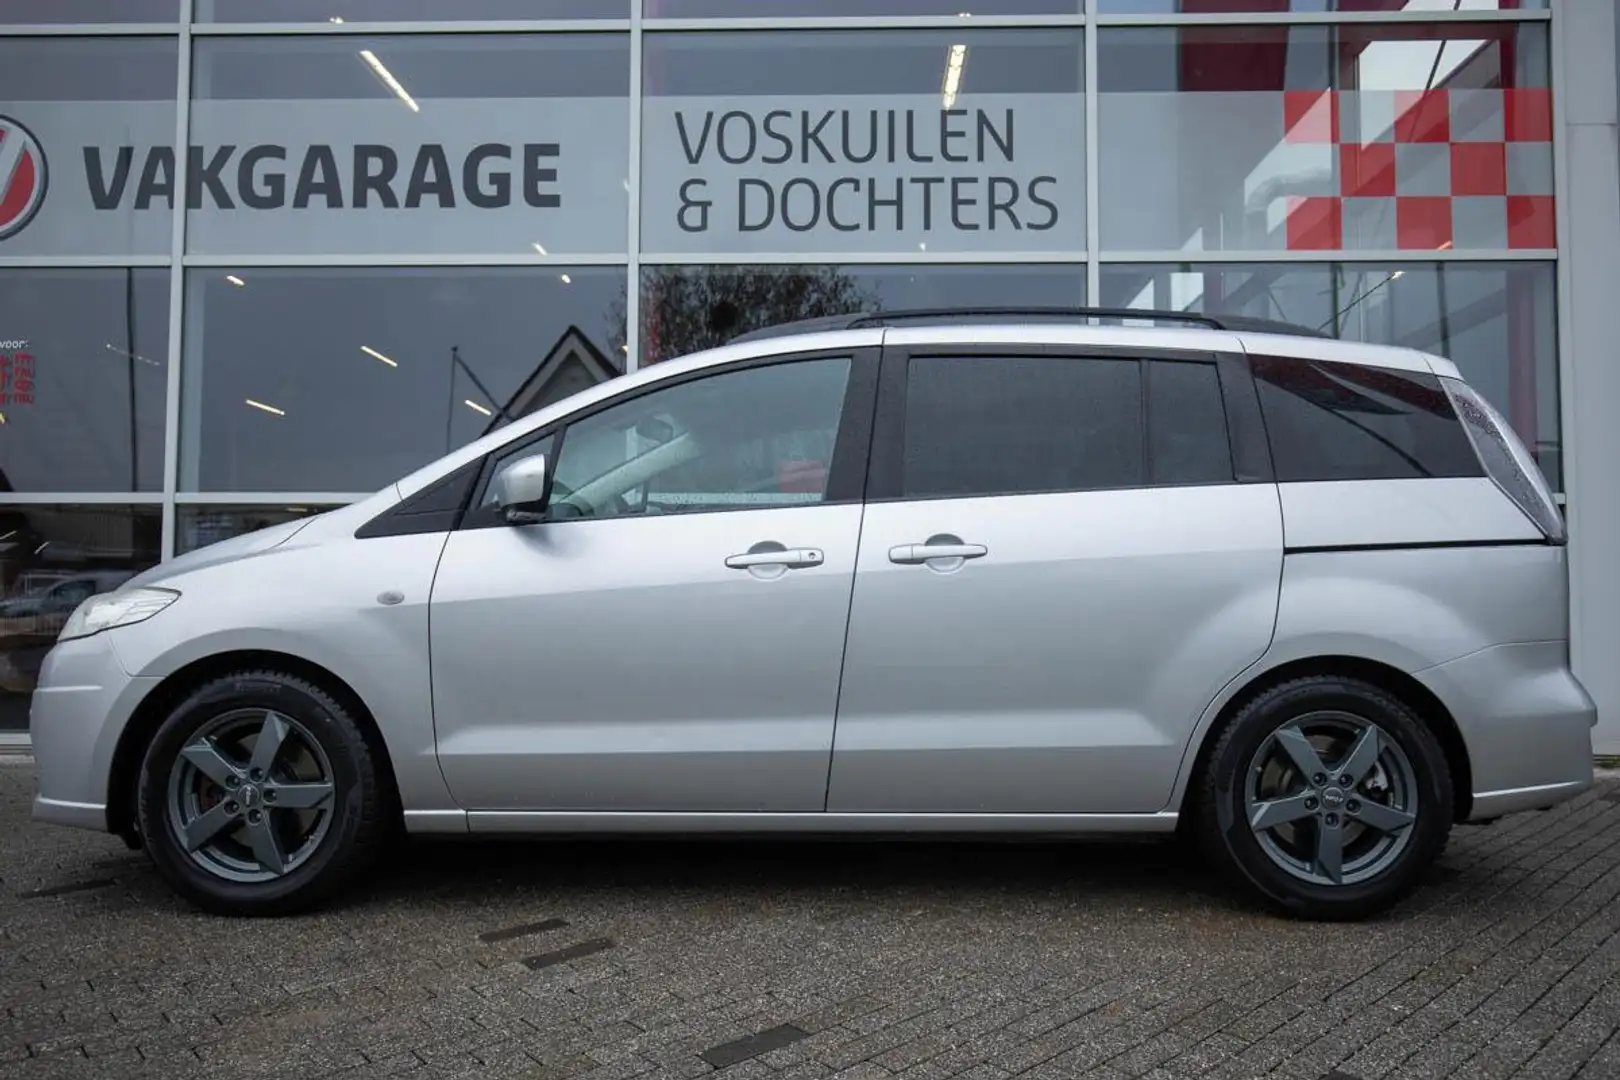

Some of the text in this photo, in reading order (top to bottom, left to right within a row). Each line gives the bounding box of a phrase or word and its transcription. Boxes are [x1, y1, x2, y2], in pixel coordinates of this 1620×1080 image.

[674, 108, 1015, 165] VOSKUILEN
[82, 142, 562, 211] VAKGARAGE
[676, 175, 1060, 233] & DOCHTERS
